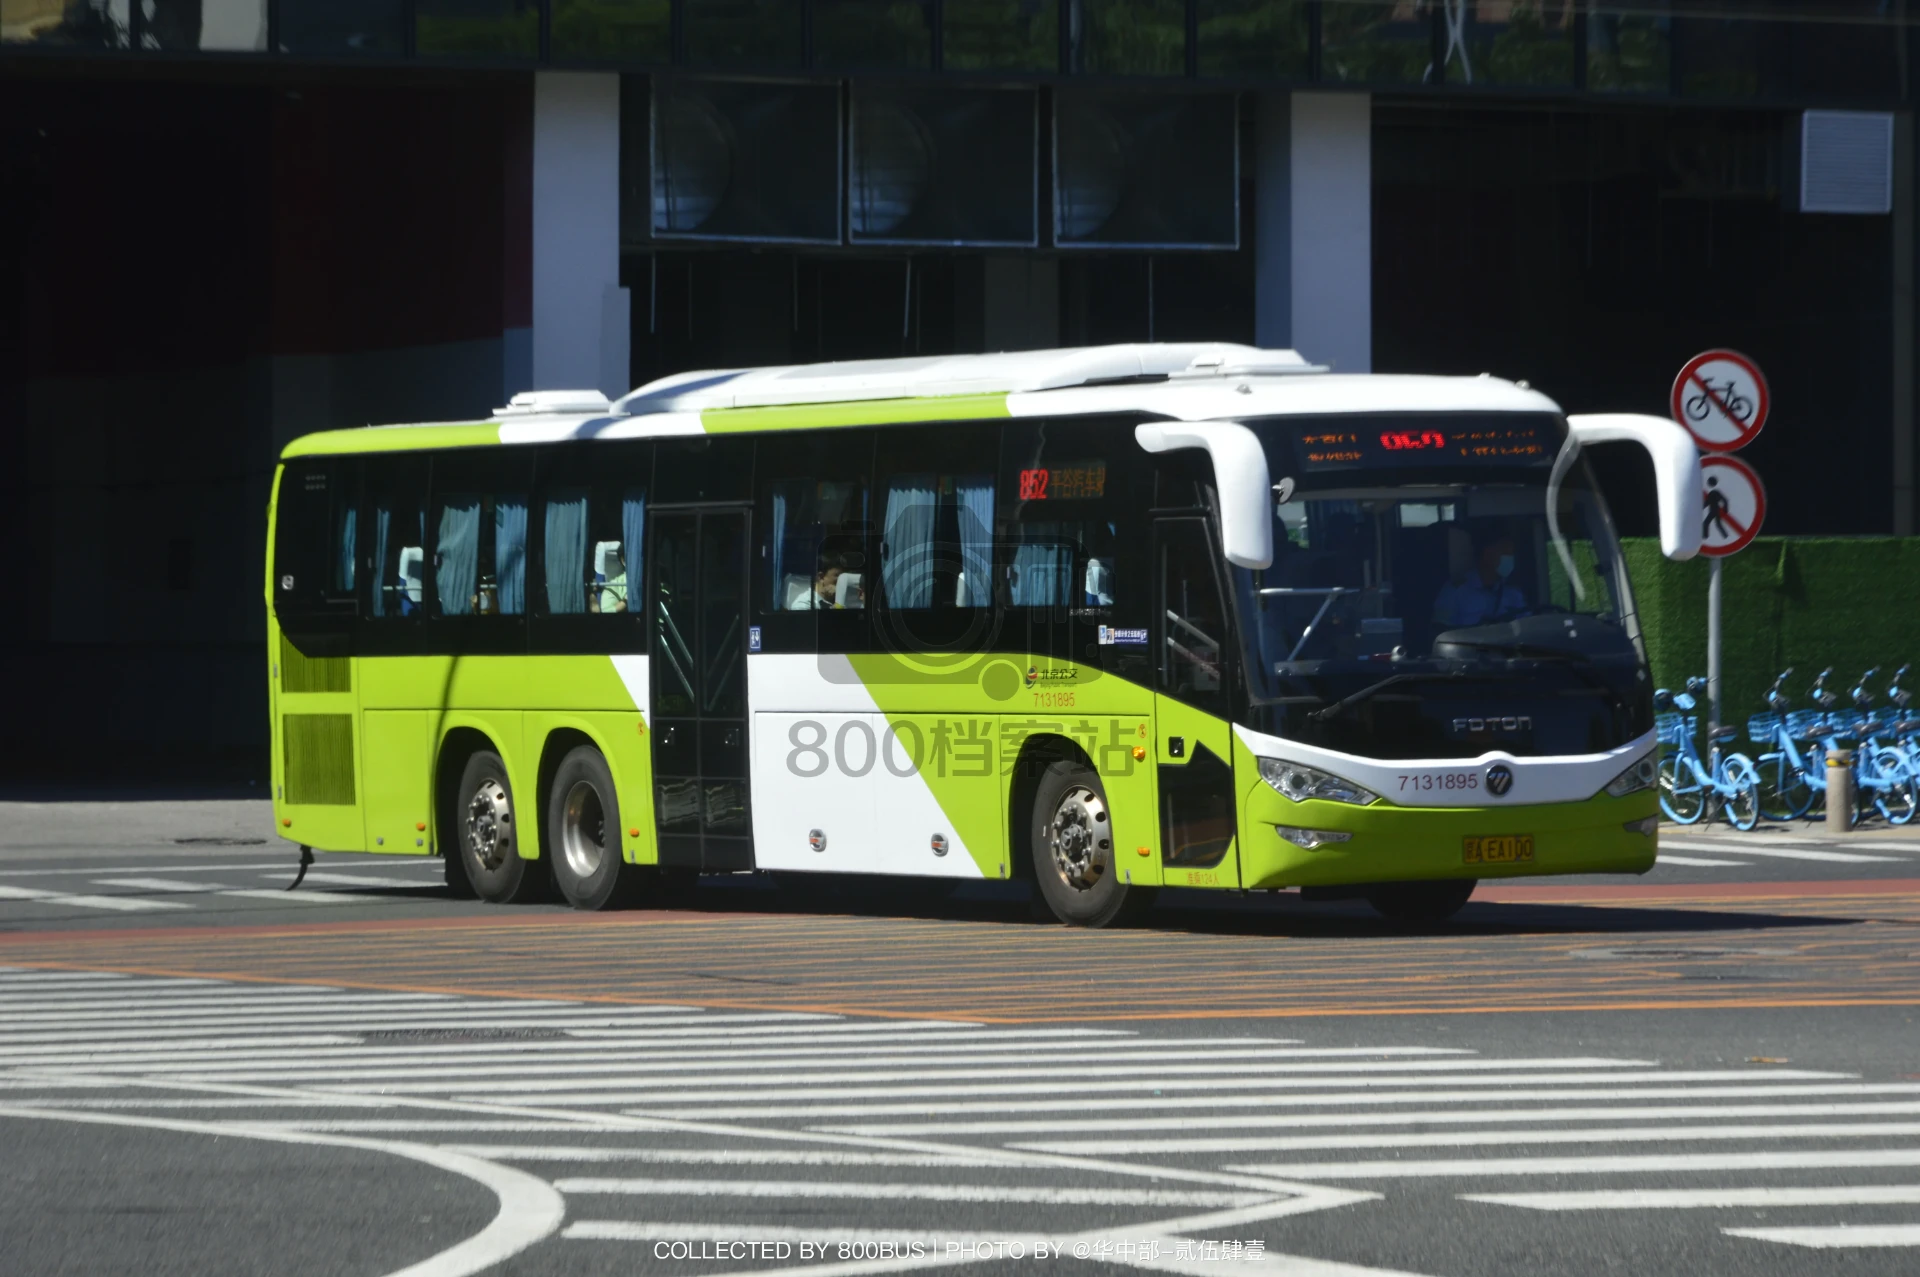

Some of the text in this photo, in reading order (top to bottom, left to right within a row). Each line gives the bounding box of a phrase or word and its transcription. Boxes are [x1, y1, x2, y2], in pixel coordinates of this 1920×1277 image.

[1019, 469, 1049, 500] 852
[1041, 668, 1078, 680] 北京公交
[1033, 692, 1075, 708] 7131895
[1453, 716, 1532, 732] FOTON
[1398, 773, 1478, 791] 7131895
